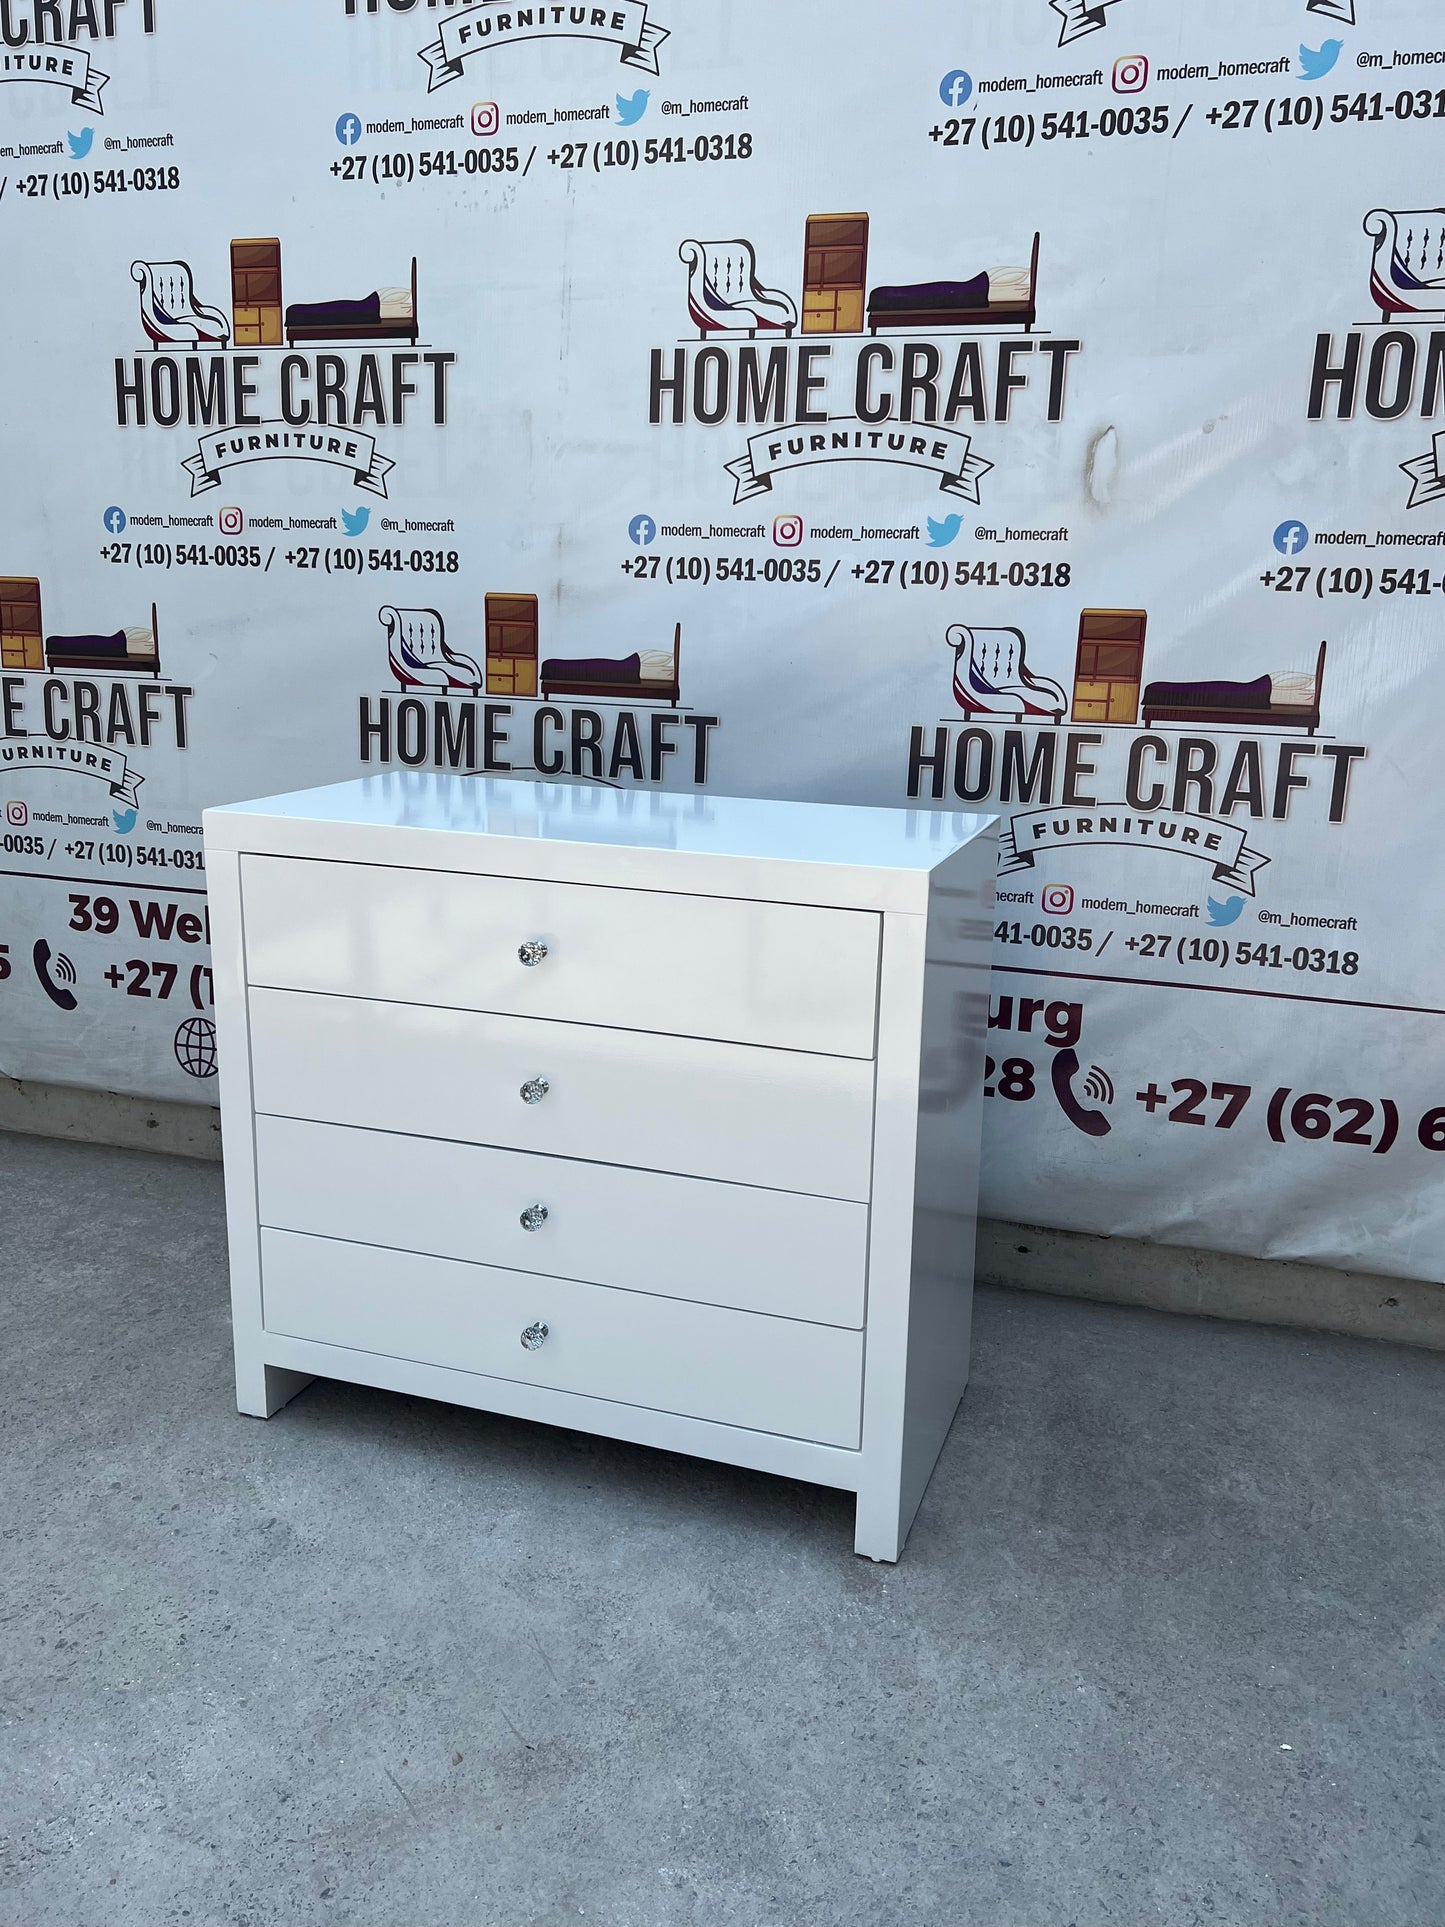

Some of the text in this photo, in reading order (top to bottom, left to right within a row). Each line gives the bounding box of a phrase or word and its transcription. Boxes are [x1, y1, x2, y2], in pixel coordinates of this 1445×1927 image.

[459, 7, 626, 44] FURNITURE
[5, 55, 73, 76] ITURE
[661, 95, 748, 117] @m_homecraft
[929, 118, 976, 146] +27
[982, 114, 1034, 150] (10)
[1041, 105, 1169, 140] 541-0035
[1206, 100, 1259, 129] +27
[1265, 96, 1323, 133] (10)
[104, 133, 174, 151] @m_homecraft
[330, 156, 367, 180] +27
[372, 153, 414, 184] (10)
[419, 147, 519, 176] 541-0035
[547, 143, 588, 168] +27
[593, 140, 639, 172] (10)
[644, 133, 752, 164] 541-0318
[16, 174, 48, 197] +27
[53, 172, 89, 200] (10)
[94, 166, 180, 193] 541-0318
[115, 353, 455, 426] HOME CRAFT
[649, 340, 1079, 425] HOME CRAFT
[215, 433, 357, 458] FURNITURE
[768, 432, 948, 460] FURNITURE
[381, 518, 455, 533] @m_homecraft
[975, 527, 1068, 543] @m_homecraft
[100, 543, 131, 563] +27
[136, 544, 171, 569] (10)
[176, 545, 261, 567] 541-0035
[285, 547, 319, 568] +27
[325, 548, 363, 575] (10)
[368, 549, 459, 573] 541-0318
[621, 556, 661, 578] +27
[666, 557, 710, 585] (10)
[716, 558, 821, 582] 541-0035
[851, 560, 894, 584] +27
[900, 561, 948, 590] (10)
[955, 561, 1071, 587] 541-0318
[1260, 566, 1445, 599] +27 (10) 541-
[0, 677, 192, 748] E CRAFT
[359, 696, 719, 785] HOME CRAFT
[2, 746, 111, 772] URNITURE
[907, 726, 1368, 822] HOME CRAFT
[1032, 818, 1222, 851] FURNITURE
[65, 841, 94, 860] +27
[99, 843, 132, 868] (10)
[69, 894, 119, 934] 39
[1258, 910, 1357, 931] @m_homecraft
[1125, 934, 1172, 957] +27
[1177, 937, 1229, 968] (10)
[1235, 942, 1359, 975] 541-0318
[104, 960, 178, 999] +27
[1136, 1078, 1251, 1129] +27
[1267, 1087, 1399, 1154] (62)
